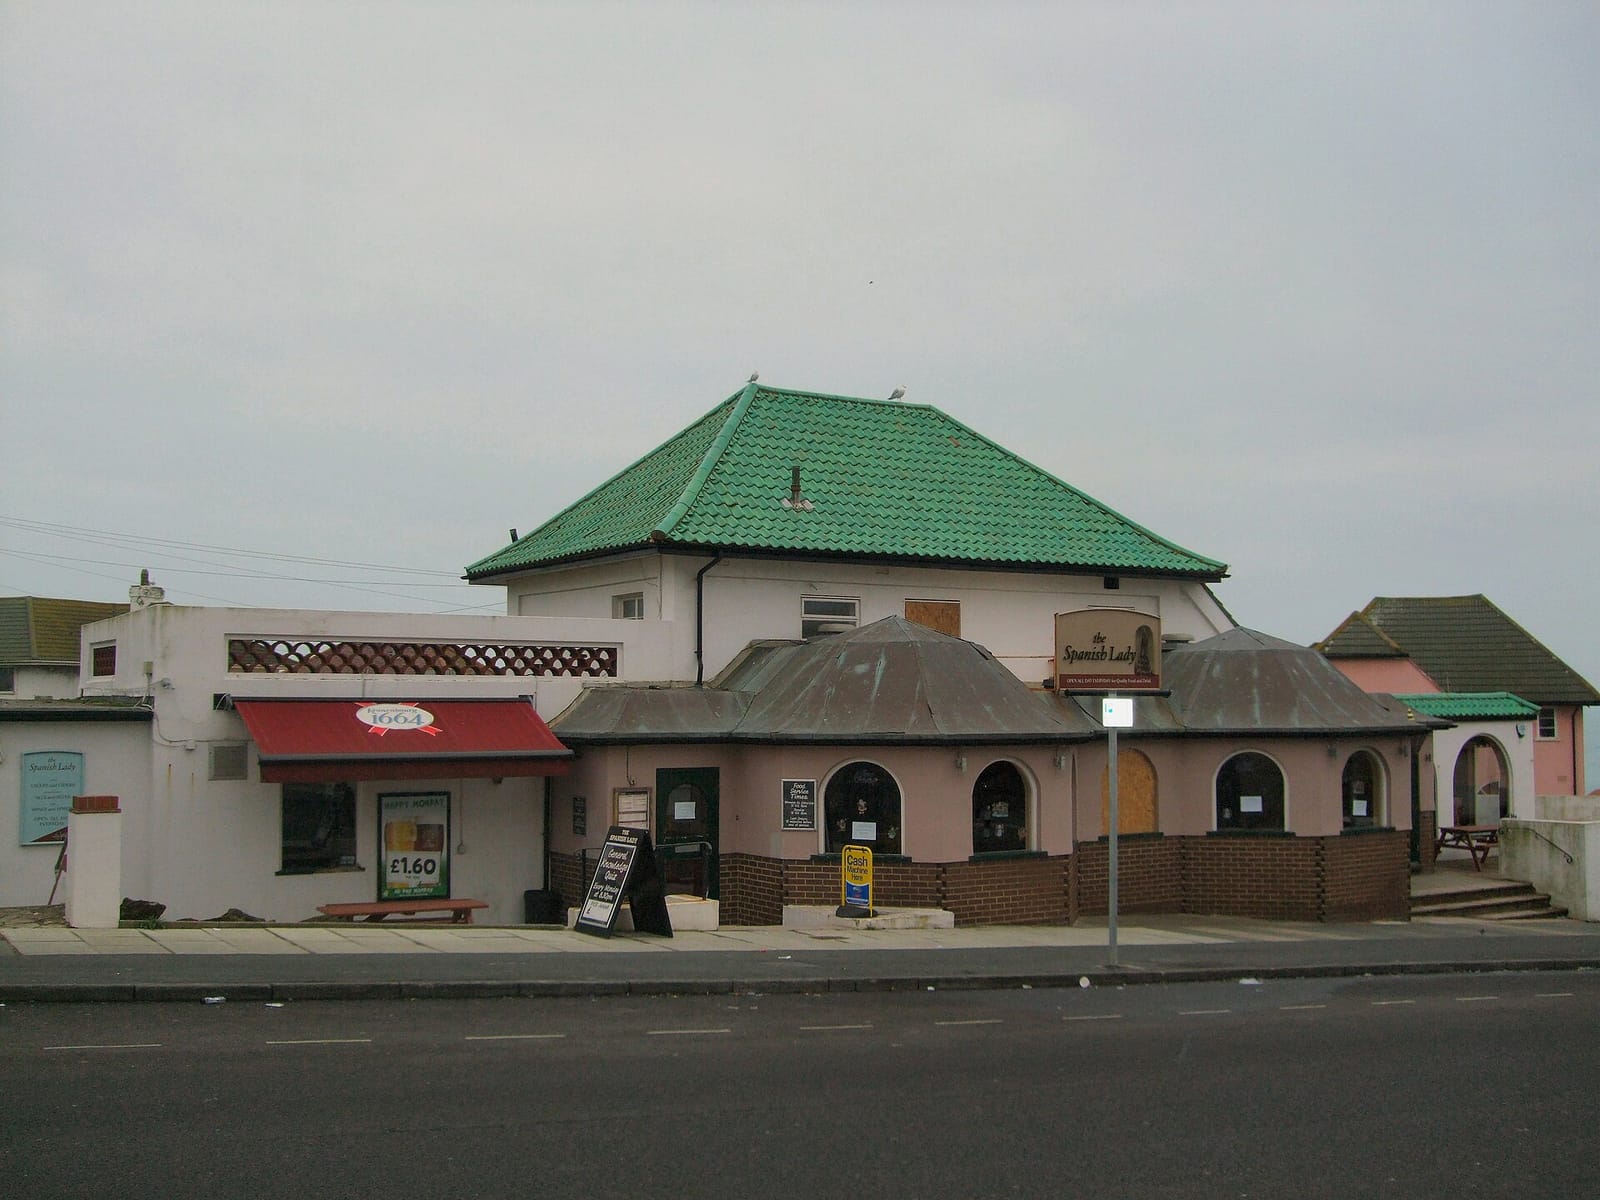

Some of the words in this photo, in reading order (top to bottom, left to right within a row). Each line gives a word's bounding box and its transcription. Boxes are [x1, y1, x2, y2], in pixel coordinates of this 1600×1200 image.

[1092, 632, 1106, 643] the
[1063, 645, 1107, 664] Spanish
[1109, 646, 1136, 665] Lady
[371, 712, 425, 726] 1664
[29, 762, 57, 773] Spanish
[58, 762, 76, 772] Lady
[608, 849, 628, 860] General
[390, 857, 436, 875] £1.60
[847, 855, 868, 867] Cash
[605, 870, 617, 880] Quiz
[847, 866, 869, 875] Machine
[851, 873, 863, 881] Here
